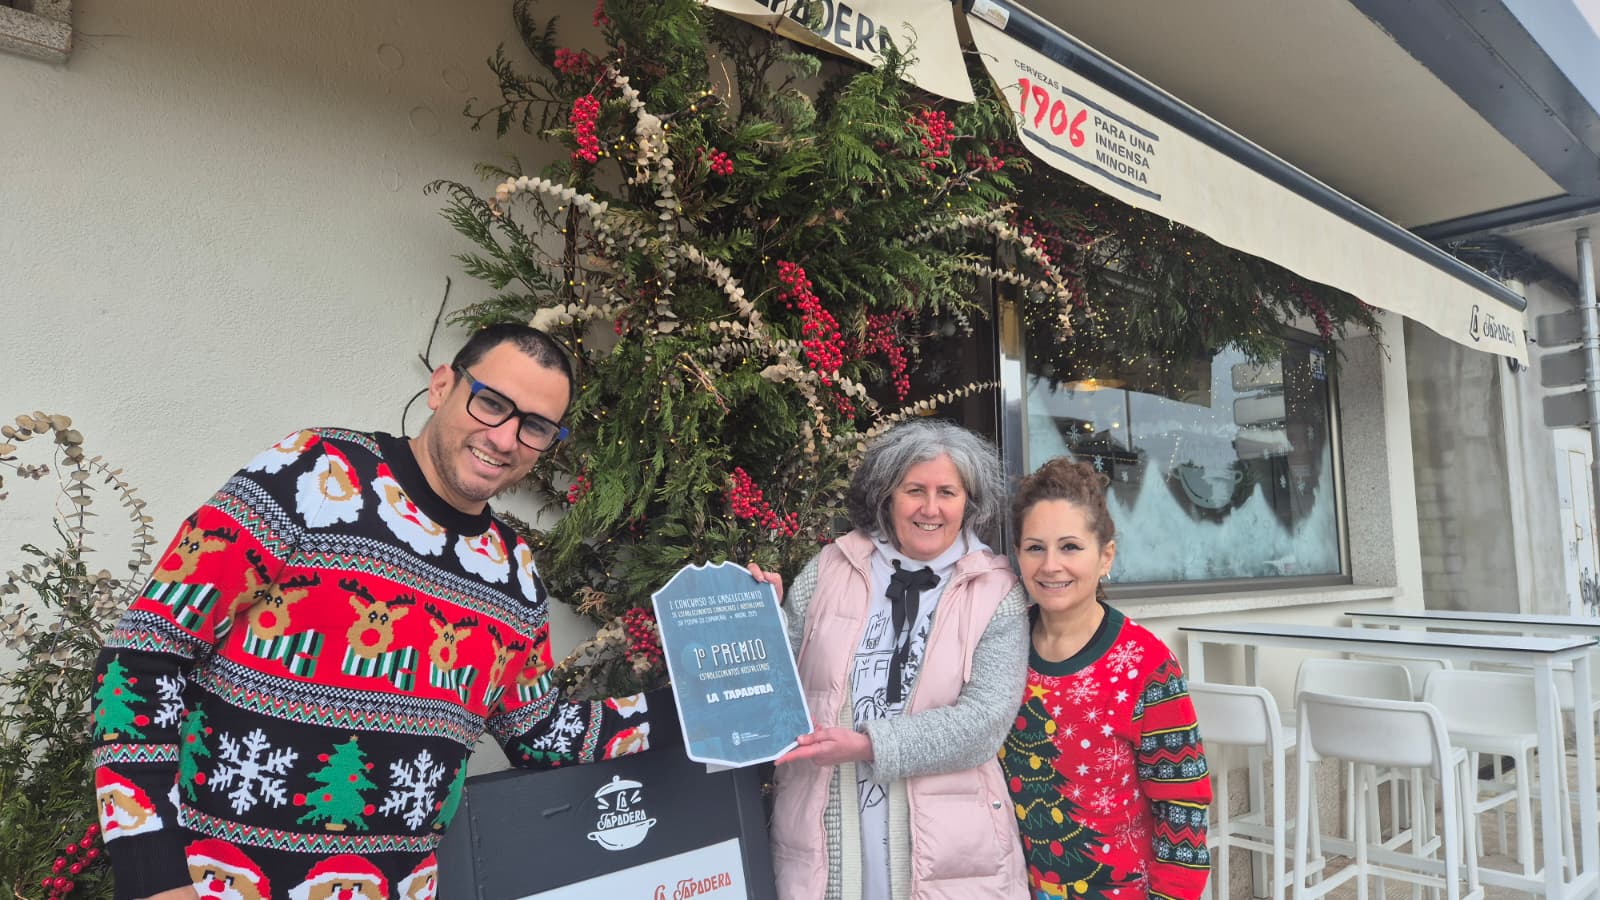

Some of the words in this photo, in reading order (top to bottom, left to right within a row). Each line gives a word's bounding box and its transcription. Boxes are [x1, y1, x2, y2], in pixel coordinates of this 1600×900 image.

[755, 0, 902, 57] ADERA
[1014, 59, 1059, 90] CERVEZAS
[1018, 78, 1087, 147] 1906
[1094, 116, 1126, 141] PARA
[1129, 135, 1155, 156] UNA
[1095, 132, 1150, 169] INMENSA
[1096, 149, 1148, 184] MINORIA
[674, 597, 707, 609] CONCURSO
[708, 595, 716, 605] DE
[694, 647, 706, 669] 1º
[711, 638, 767, 667] PREMIO
[706, 692, 720, 704] LA
[723, 683, 774, 700] TAPADERA
[616, 790, 630, 812] LA
[597, 810, 647, 831] TAPADERA
[673, 872, 732, 900] TAPADERA
